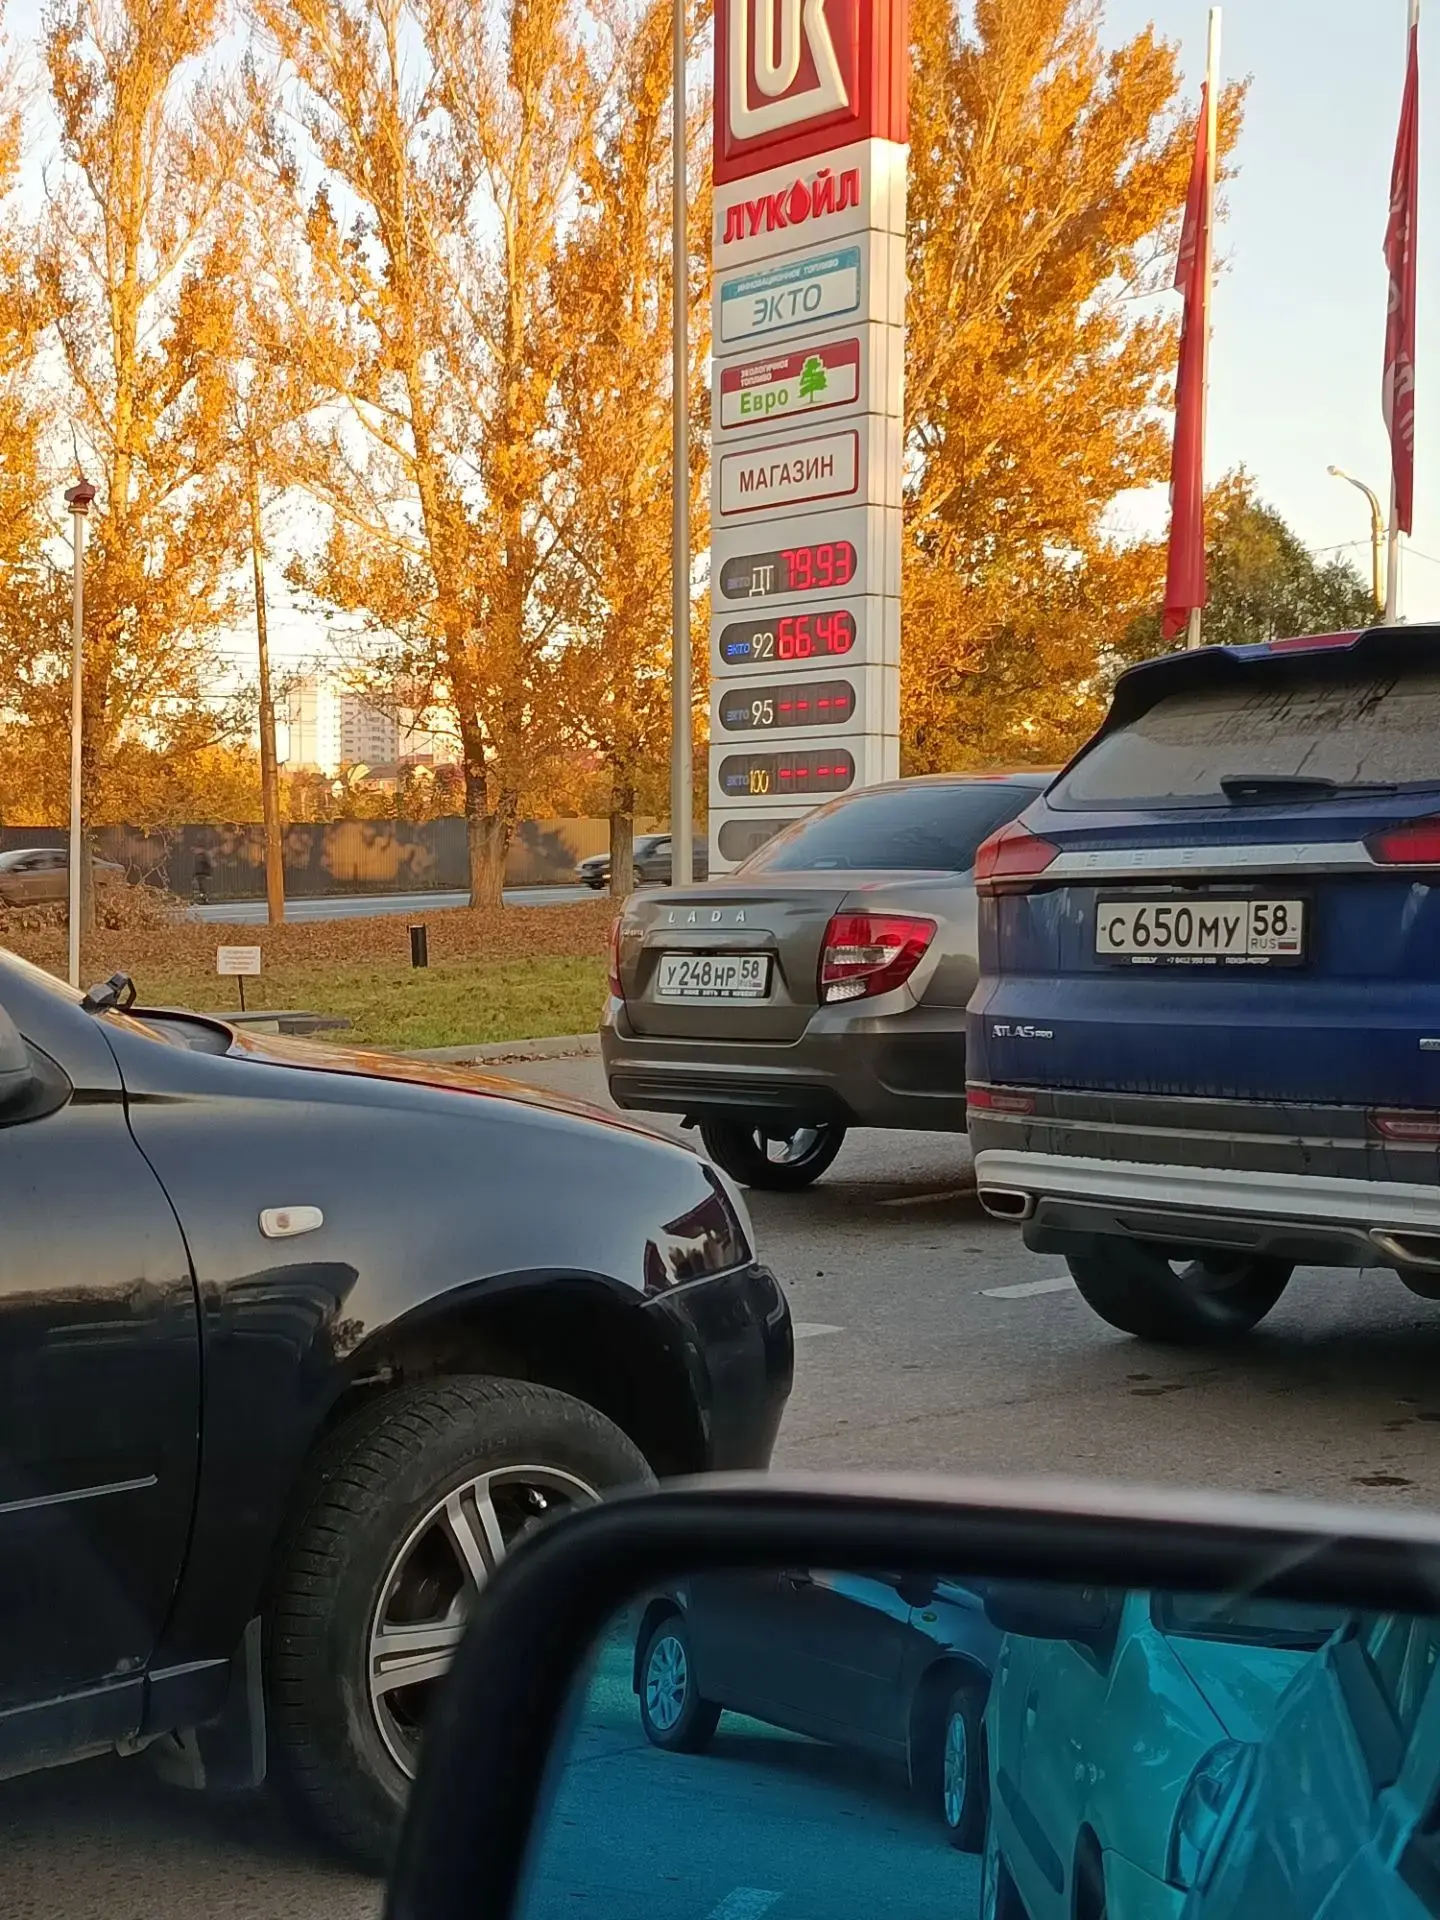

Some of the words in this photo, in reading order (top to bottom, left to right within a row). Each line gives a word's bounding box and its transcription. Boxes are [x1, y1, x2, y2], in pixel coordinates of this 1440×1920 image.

[723, 168, 859, 244] ЛУКОЙЛ
[752, 283, 822, 326] ЭКТО
[740, 388, 789, 415] Евро
[739, 454, 834, 493] МАГАЗИН
[749, 564, 775, 598] ДТ
[727, 643, 750, 656] ЭКТО
[752, 632, 774, 658] 92
[778, 611, 850, 659] 66.46
[752, 699, 774, 726] 95
[749, 769, 769, 794] 100
[668, 910, 746, 924] LADA
[1108, 907, 1240, 948] С650МУ
[1253, 904, 1288, 937] 58
[1251, 937, 1277, 949] RUS
[741, 960, 760, 979] 58
[992, 1024, 1035, 1038] ATLAS
